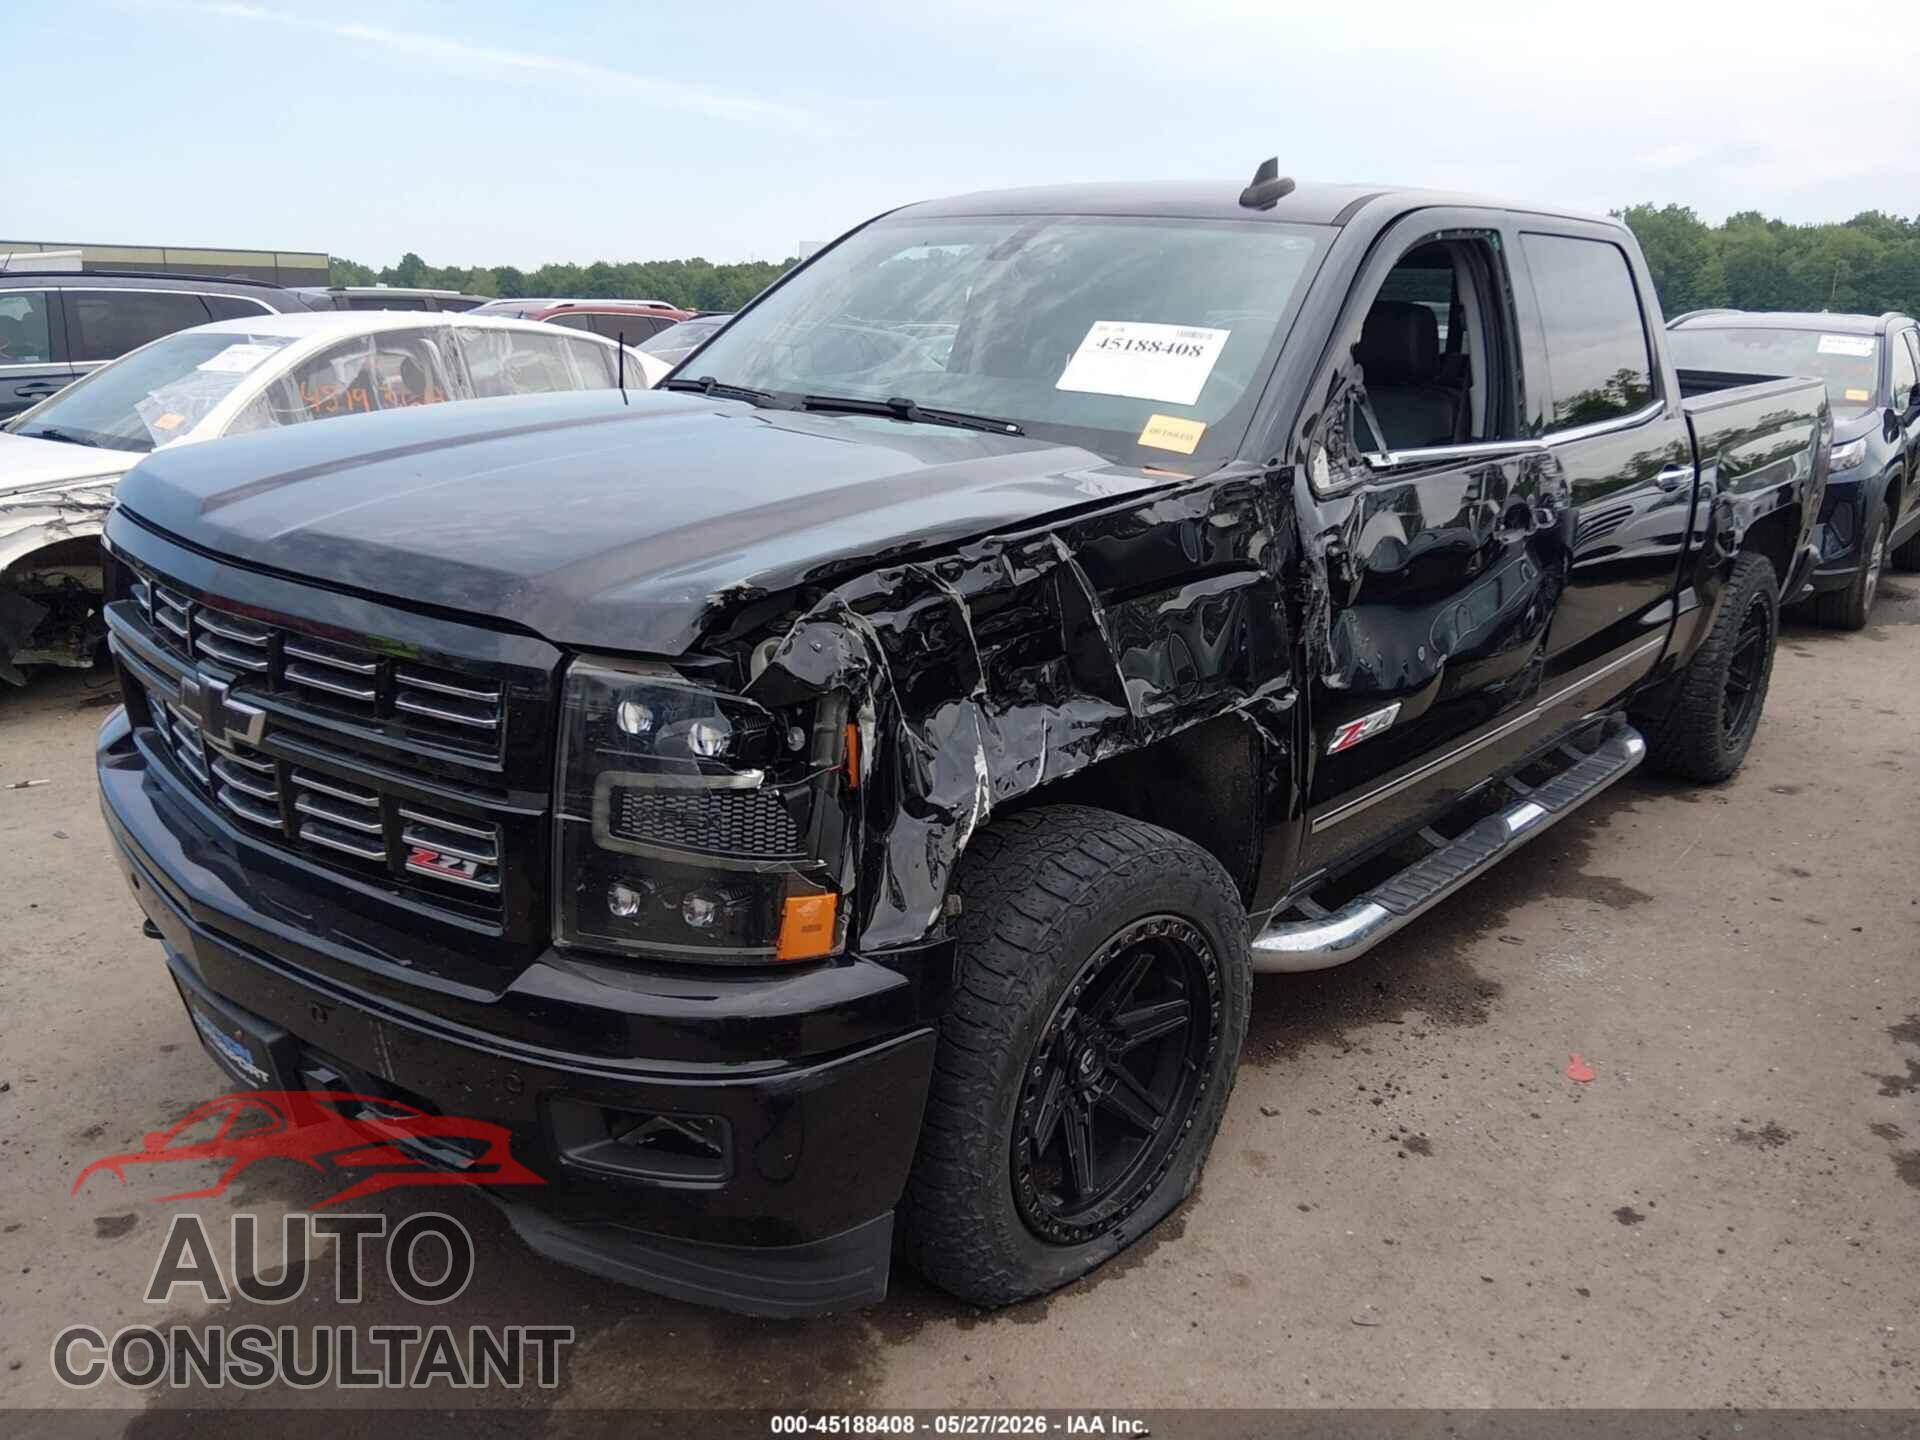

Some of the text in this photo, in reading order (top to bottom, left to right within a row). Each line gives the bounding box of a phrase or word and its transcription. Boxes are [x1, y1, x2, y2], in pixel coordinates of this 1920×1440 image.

[1095, 337, 1204, 357] 45188408
[1327, 703, 1402, 755] Z71
[406, 846, 479, 880] Z71
